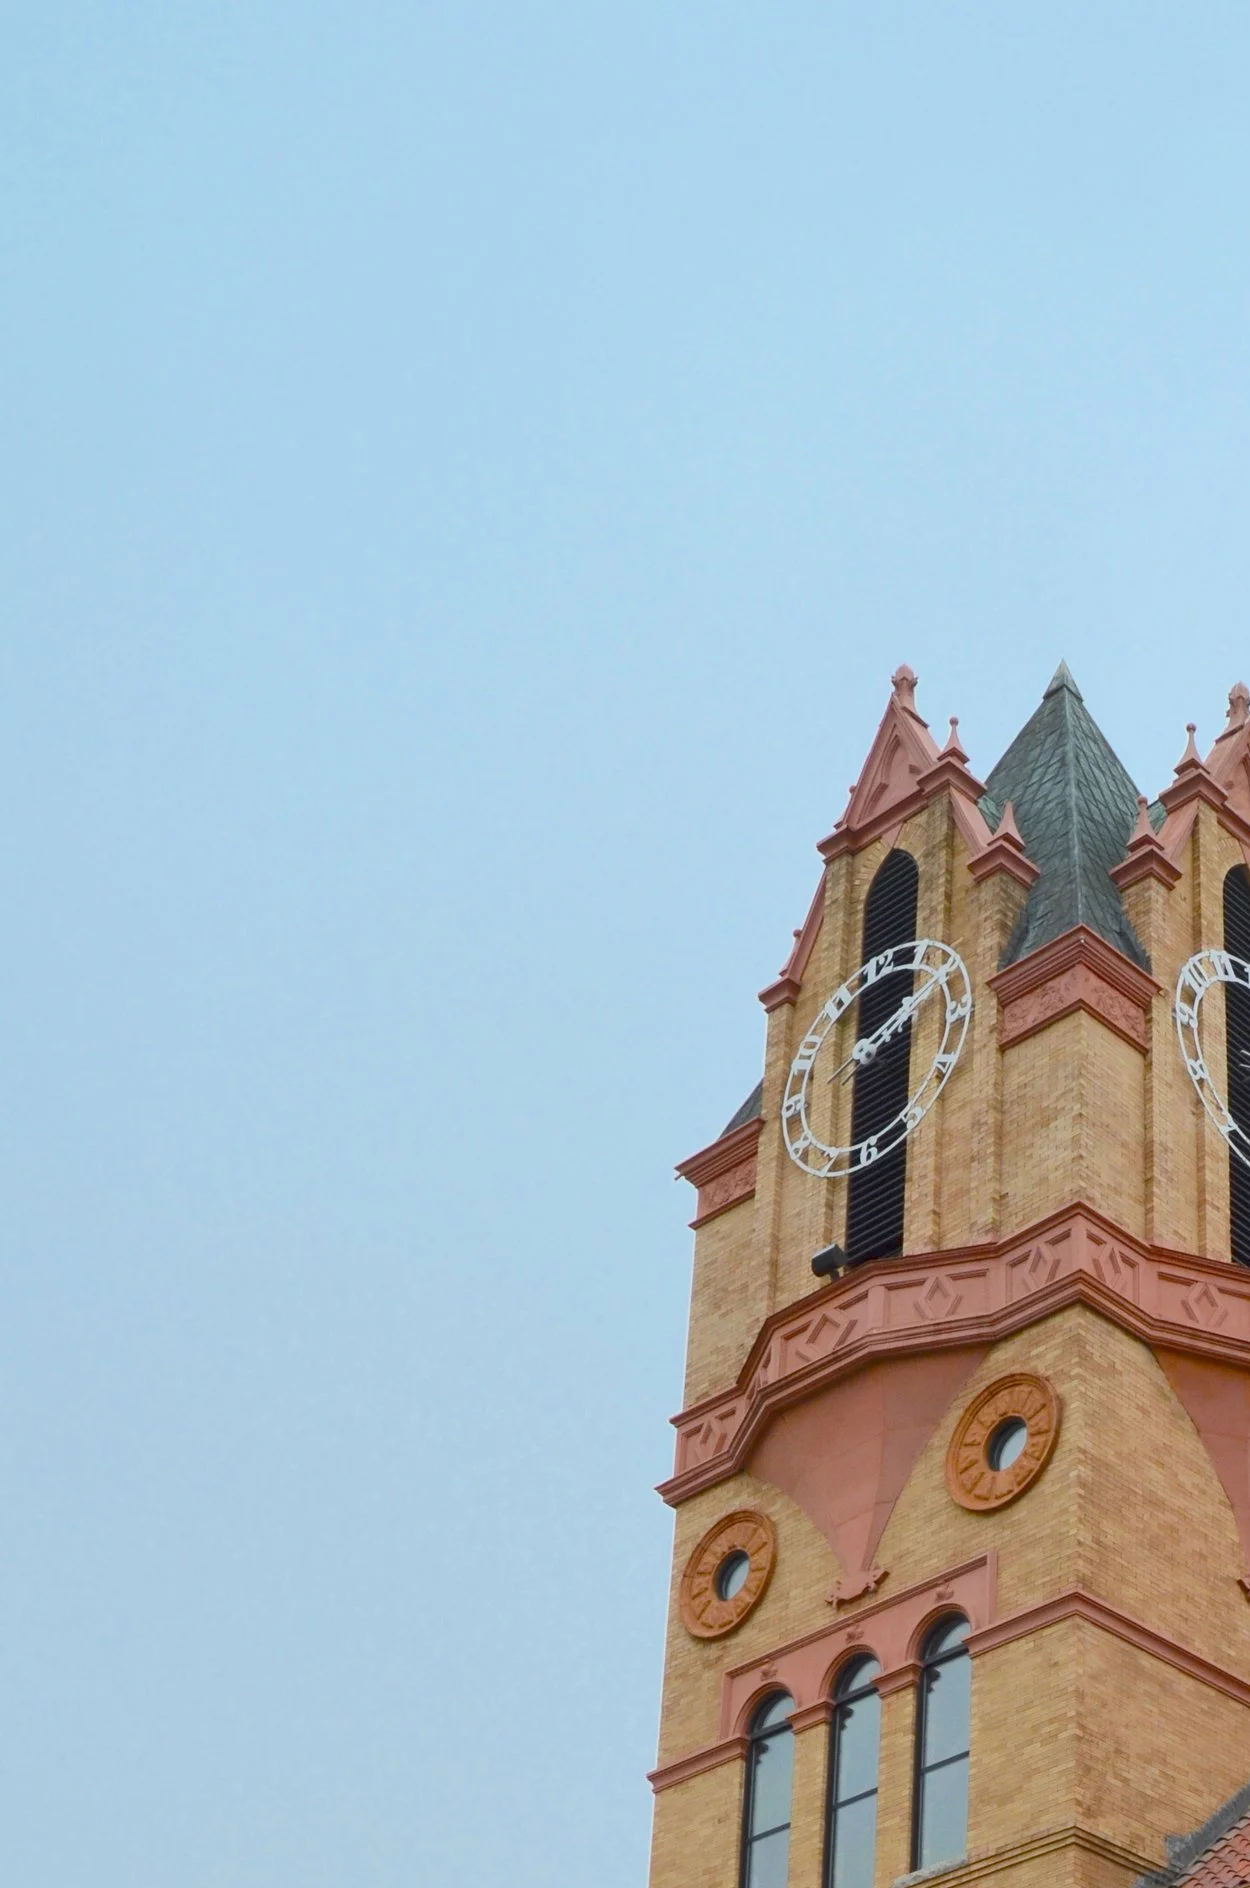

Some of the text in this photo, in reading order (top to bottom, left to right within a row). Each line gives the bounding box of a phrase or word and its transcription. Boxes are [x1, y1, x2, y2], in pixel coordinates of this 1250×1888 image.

[862, 949, 895, 984] 12
[1209, 950, 1237, 982] 11
[823, 984, 853, 1021] 11
[946, 994, 974, 1023] 3
[1175, 1001, 1198, 1030] 9
[792, 1034, 823, 1075] 10
[934, 1051, 958, 1074] 4
[1187, 1058, 1211, 1081] 8
[781, 1092, 808, 1119] 9
[901, 1105, 925, 1132] 5
[789, 1129, 812, 1160] 8
[859, 1136, 878, 1166] 6
[821, 1146, 841, 1177] 7
